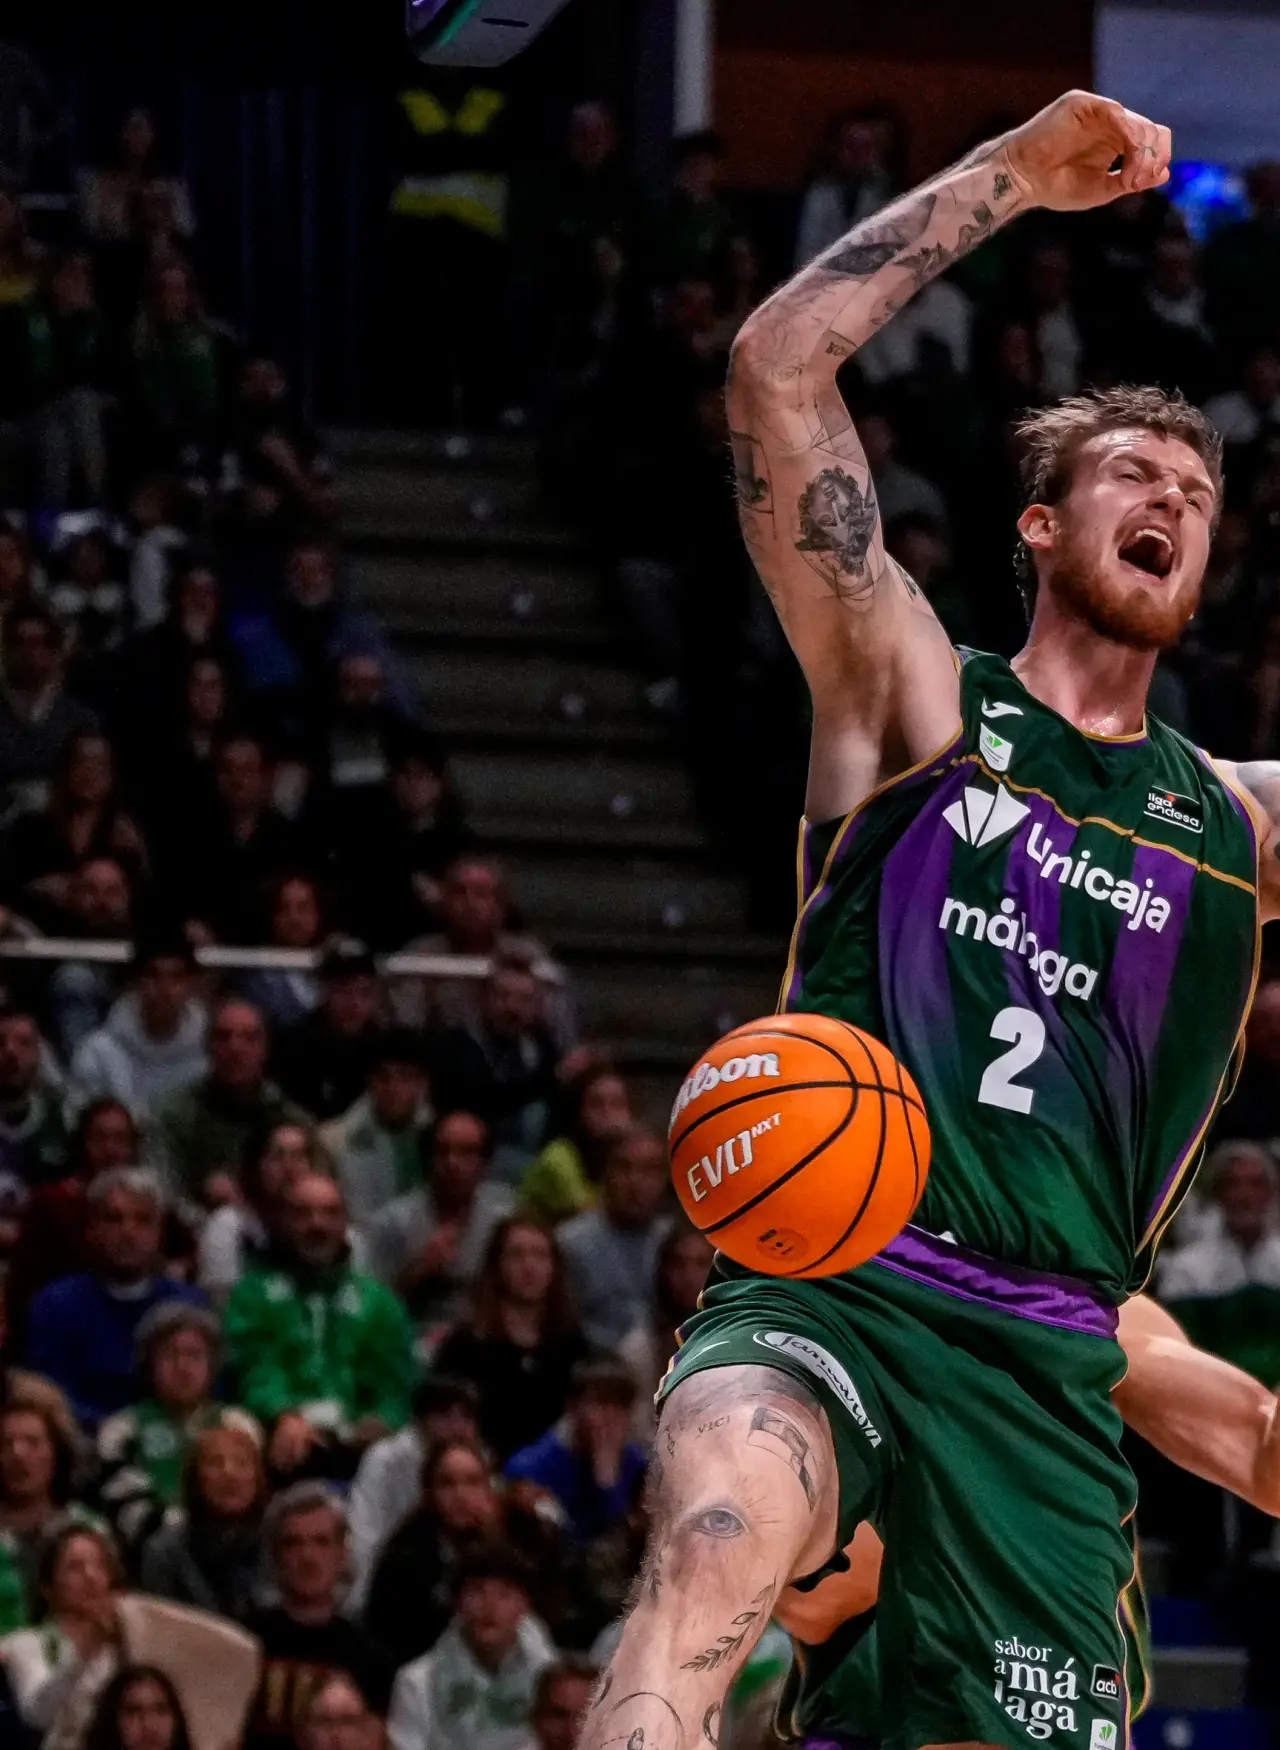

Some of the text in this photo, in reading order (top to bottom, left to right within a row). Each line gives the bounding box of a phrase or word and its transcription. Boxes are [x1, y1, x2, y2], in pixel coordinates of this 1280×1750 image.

[1147, 792, 1173, 808] liga
[1146, 802, 1200, 828] endesa
[977, 1006, 1046, 1115] 2
[751, 1112, 781, 1138] NXT
[994, 1636, 1052, 1663] sabor
[1095, 1679, 1118, 1695] acb
